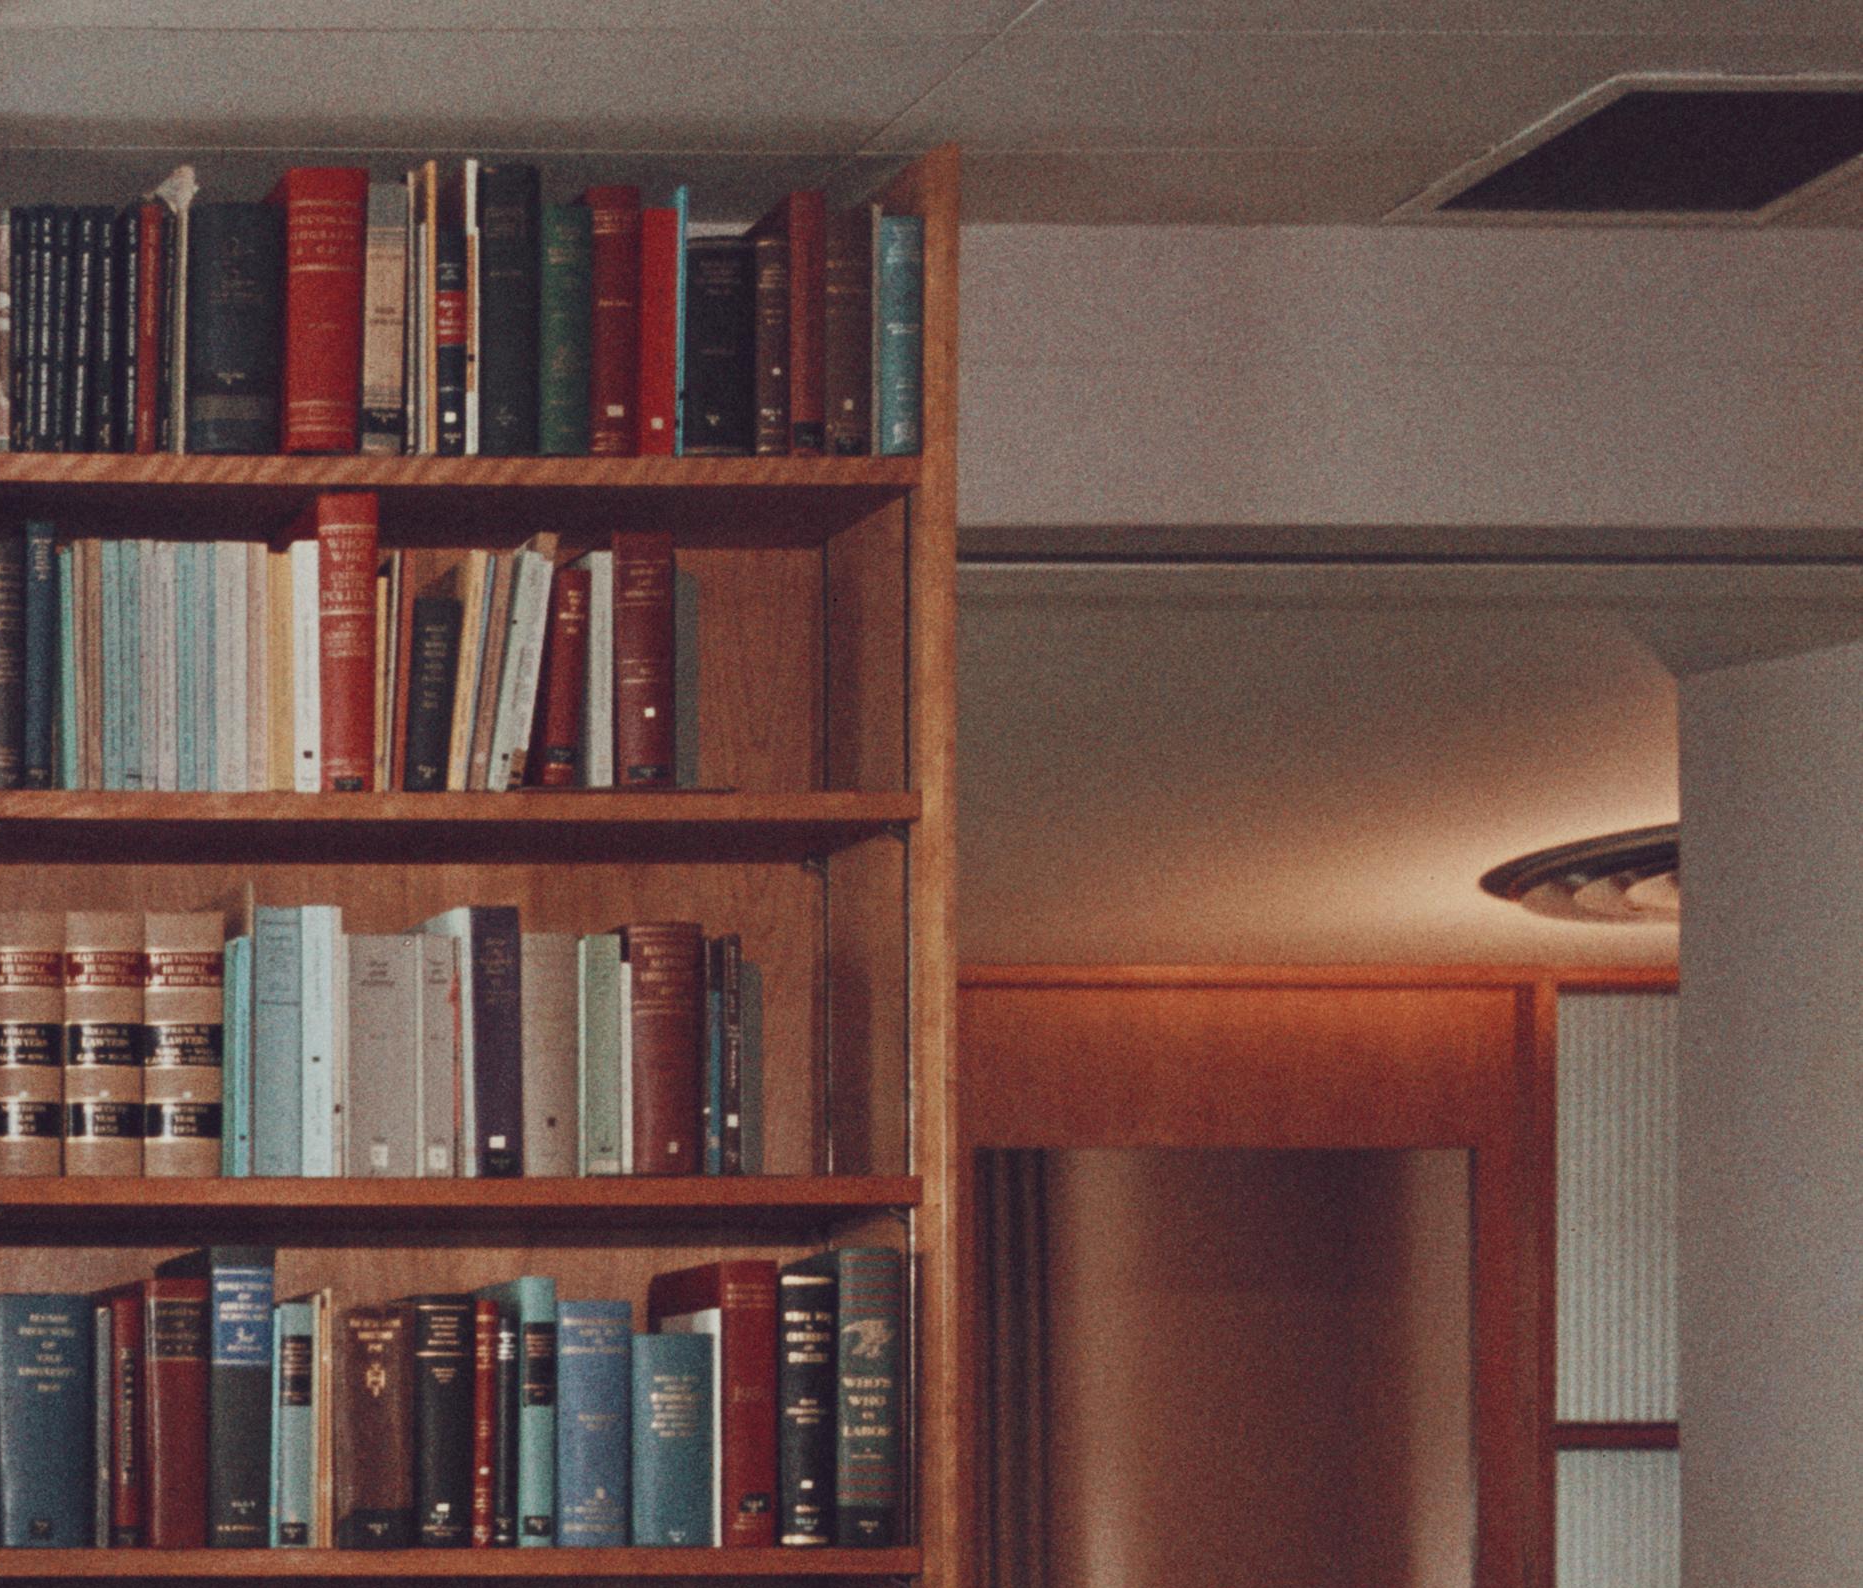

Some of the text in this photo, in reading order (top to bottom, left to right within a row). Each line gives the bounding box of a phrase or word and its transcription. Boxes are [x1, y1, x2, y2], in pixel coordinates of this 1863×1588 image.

[843, 1376, 892, 1389] WHO'S
[848, 1395, 887, 1407] WHO
[843, 1425, 891, 1438] LABOR
